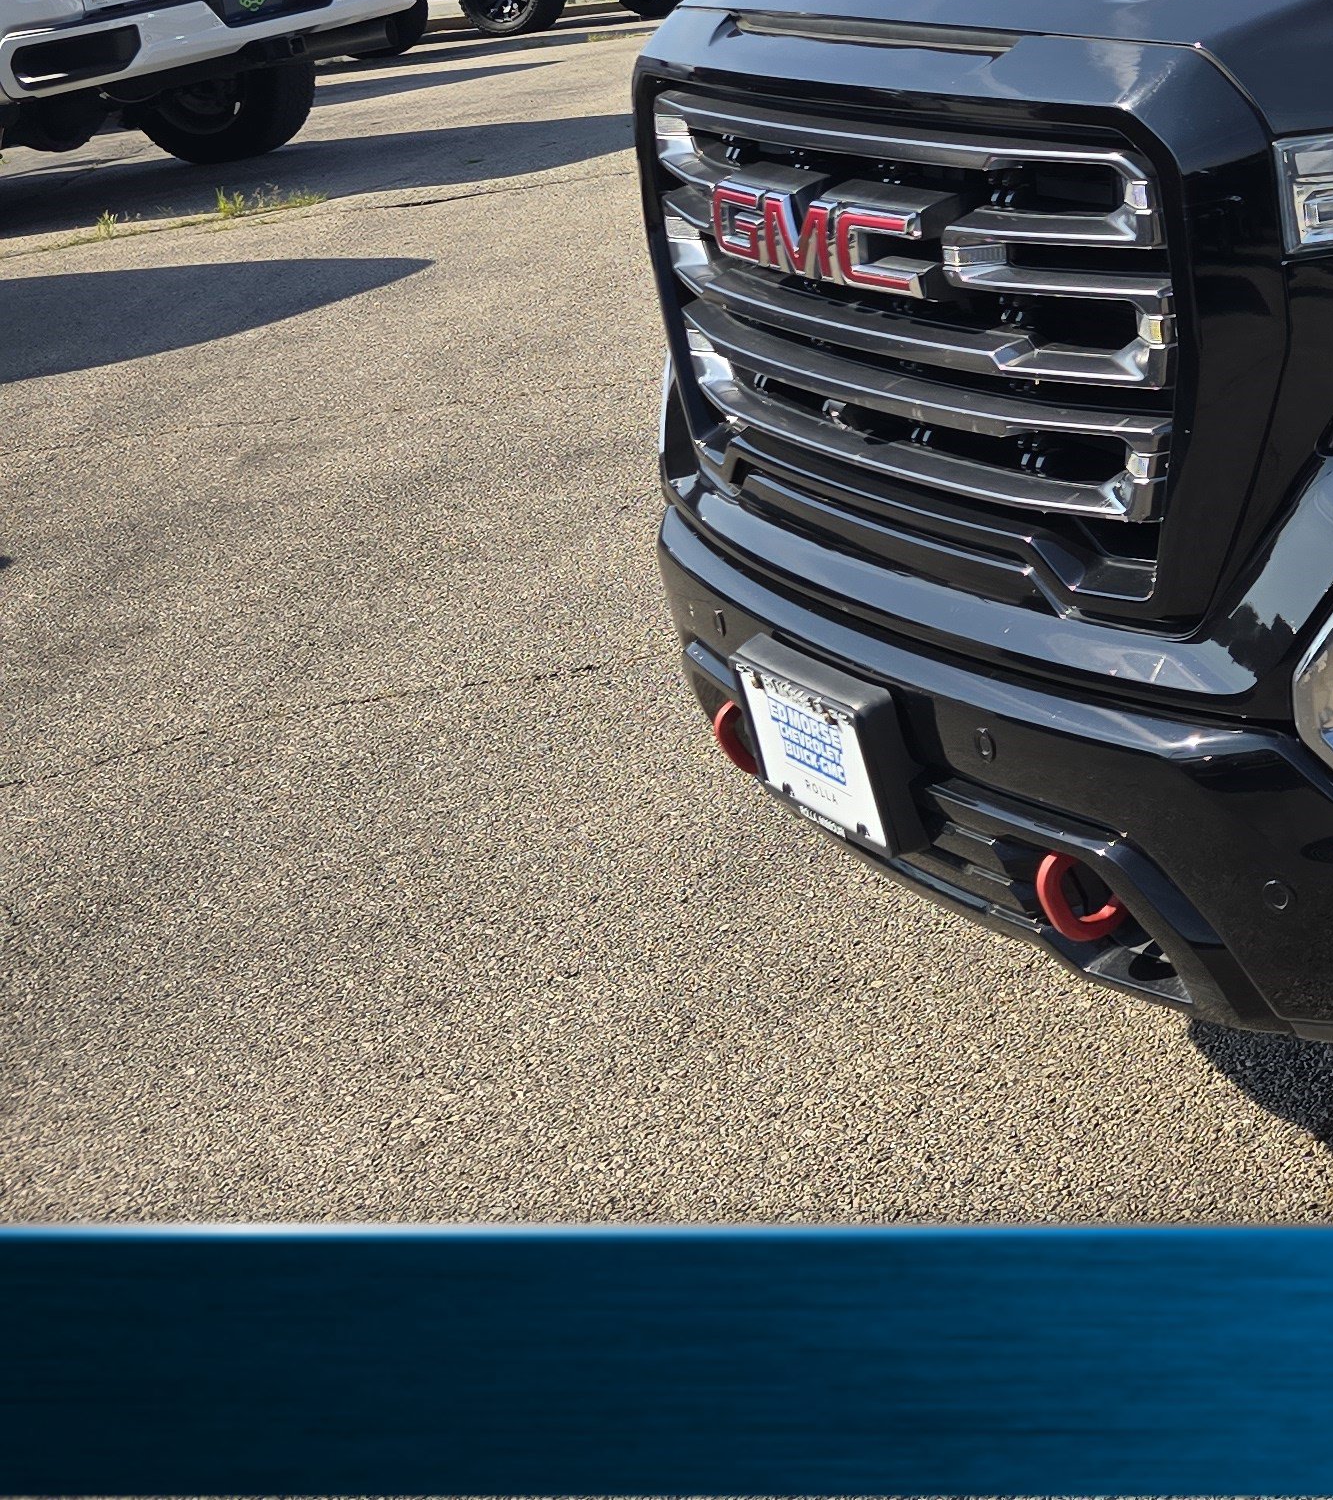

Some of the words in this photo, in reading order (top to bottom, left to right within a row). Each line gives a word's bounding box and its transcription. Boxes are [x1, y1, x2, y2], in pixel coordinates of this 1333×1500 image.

[712, 179, 924, 299] GMC
[768, 698, 790, 726] ED
[786, 706, 842, 751] MORSE
[779, 722, 842, 765] CHEVROLET
[804, 779, 839, 805] ROLLA
